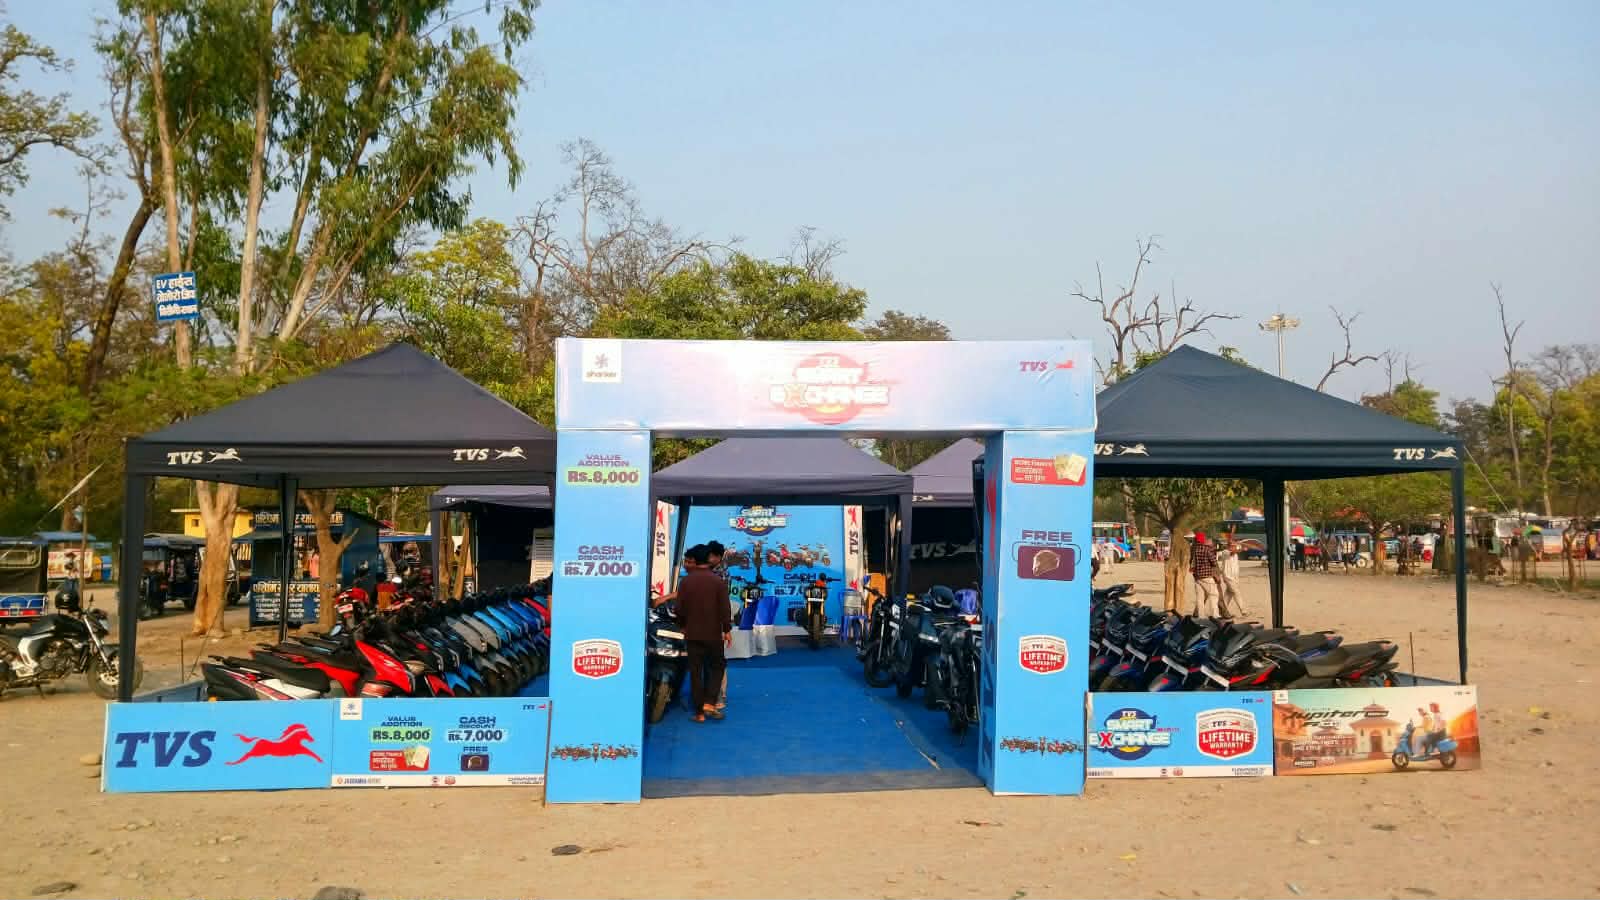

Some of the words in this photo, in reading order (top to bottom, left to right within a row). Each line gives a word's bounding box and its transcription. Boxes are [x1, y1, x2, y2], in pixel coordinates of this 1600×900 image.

[156, 279, 167, 289] EV
[1020, 361, 1048, 372] TVS
[769, 383, 889, 407] EXCHANGE
[452, 448, 490, 461] TVS
[1093, 443, 1115, 456] VS
[1393, 448, 1426, 460] TVS
[167, 451, 204, 466] TVS
[578, 459, 630, 467] ADDITION
[729, 517, 786, 529] EXCHANGE
[1022, 529, 1073, 542] FREE
[656, 531, 666, 557] TVS
[850, 530, 859, 555] TVS
[578, 545, 625, 555] CASH
[577, 656, 617, 666] LIFETIME
[1024, 652, 1063, 662] LIFETIME
[459, 716, 497, 724] CASH
[1283, 709, 1365, 721] Jupiter
[1106, 719, 1154, 732] SMART
[1088, 731, 1171, 749] EXCHANGE
[1202, 732, 1251, 743] LIFETIME
[115, 731, 217, 768] TVS
